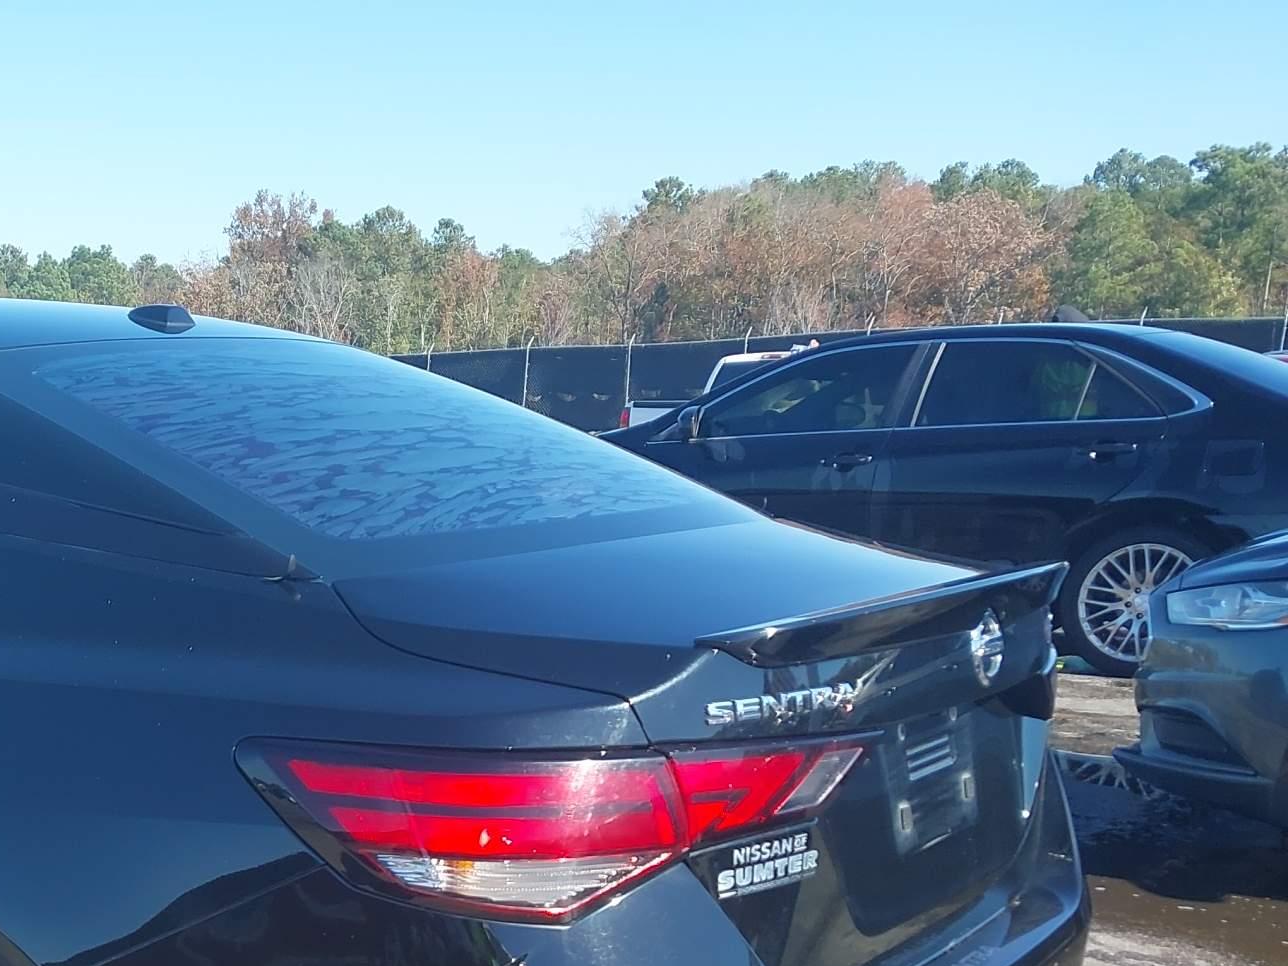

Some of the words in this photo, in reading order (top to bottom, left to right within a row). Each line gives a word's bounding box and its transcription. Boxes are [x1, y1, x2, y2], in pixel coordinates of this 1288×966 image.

[704, 683, 856, 725] SENTRA
[733, 837, 793, 866] NISSAN
[794, 833, 809, 852] OF
[717, 850, 819, 892] SUMTER
